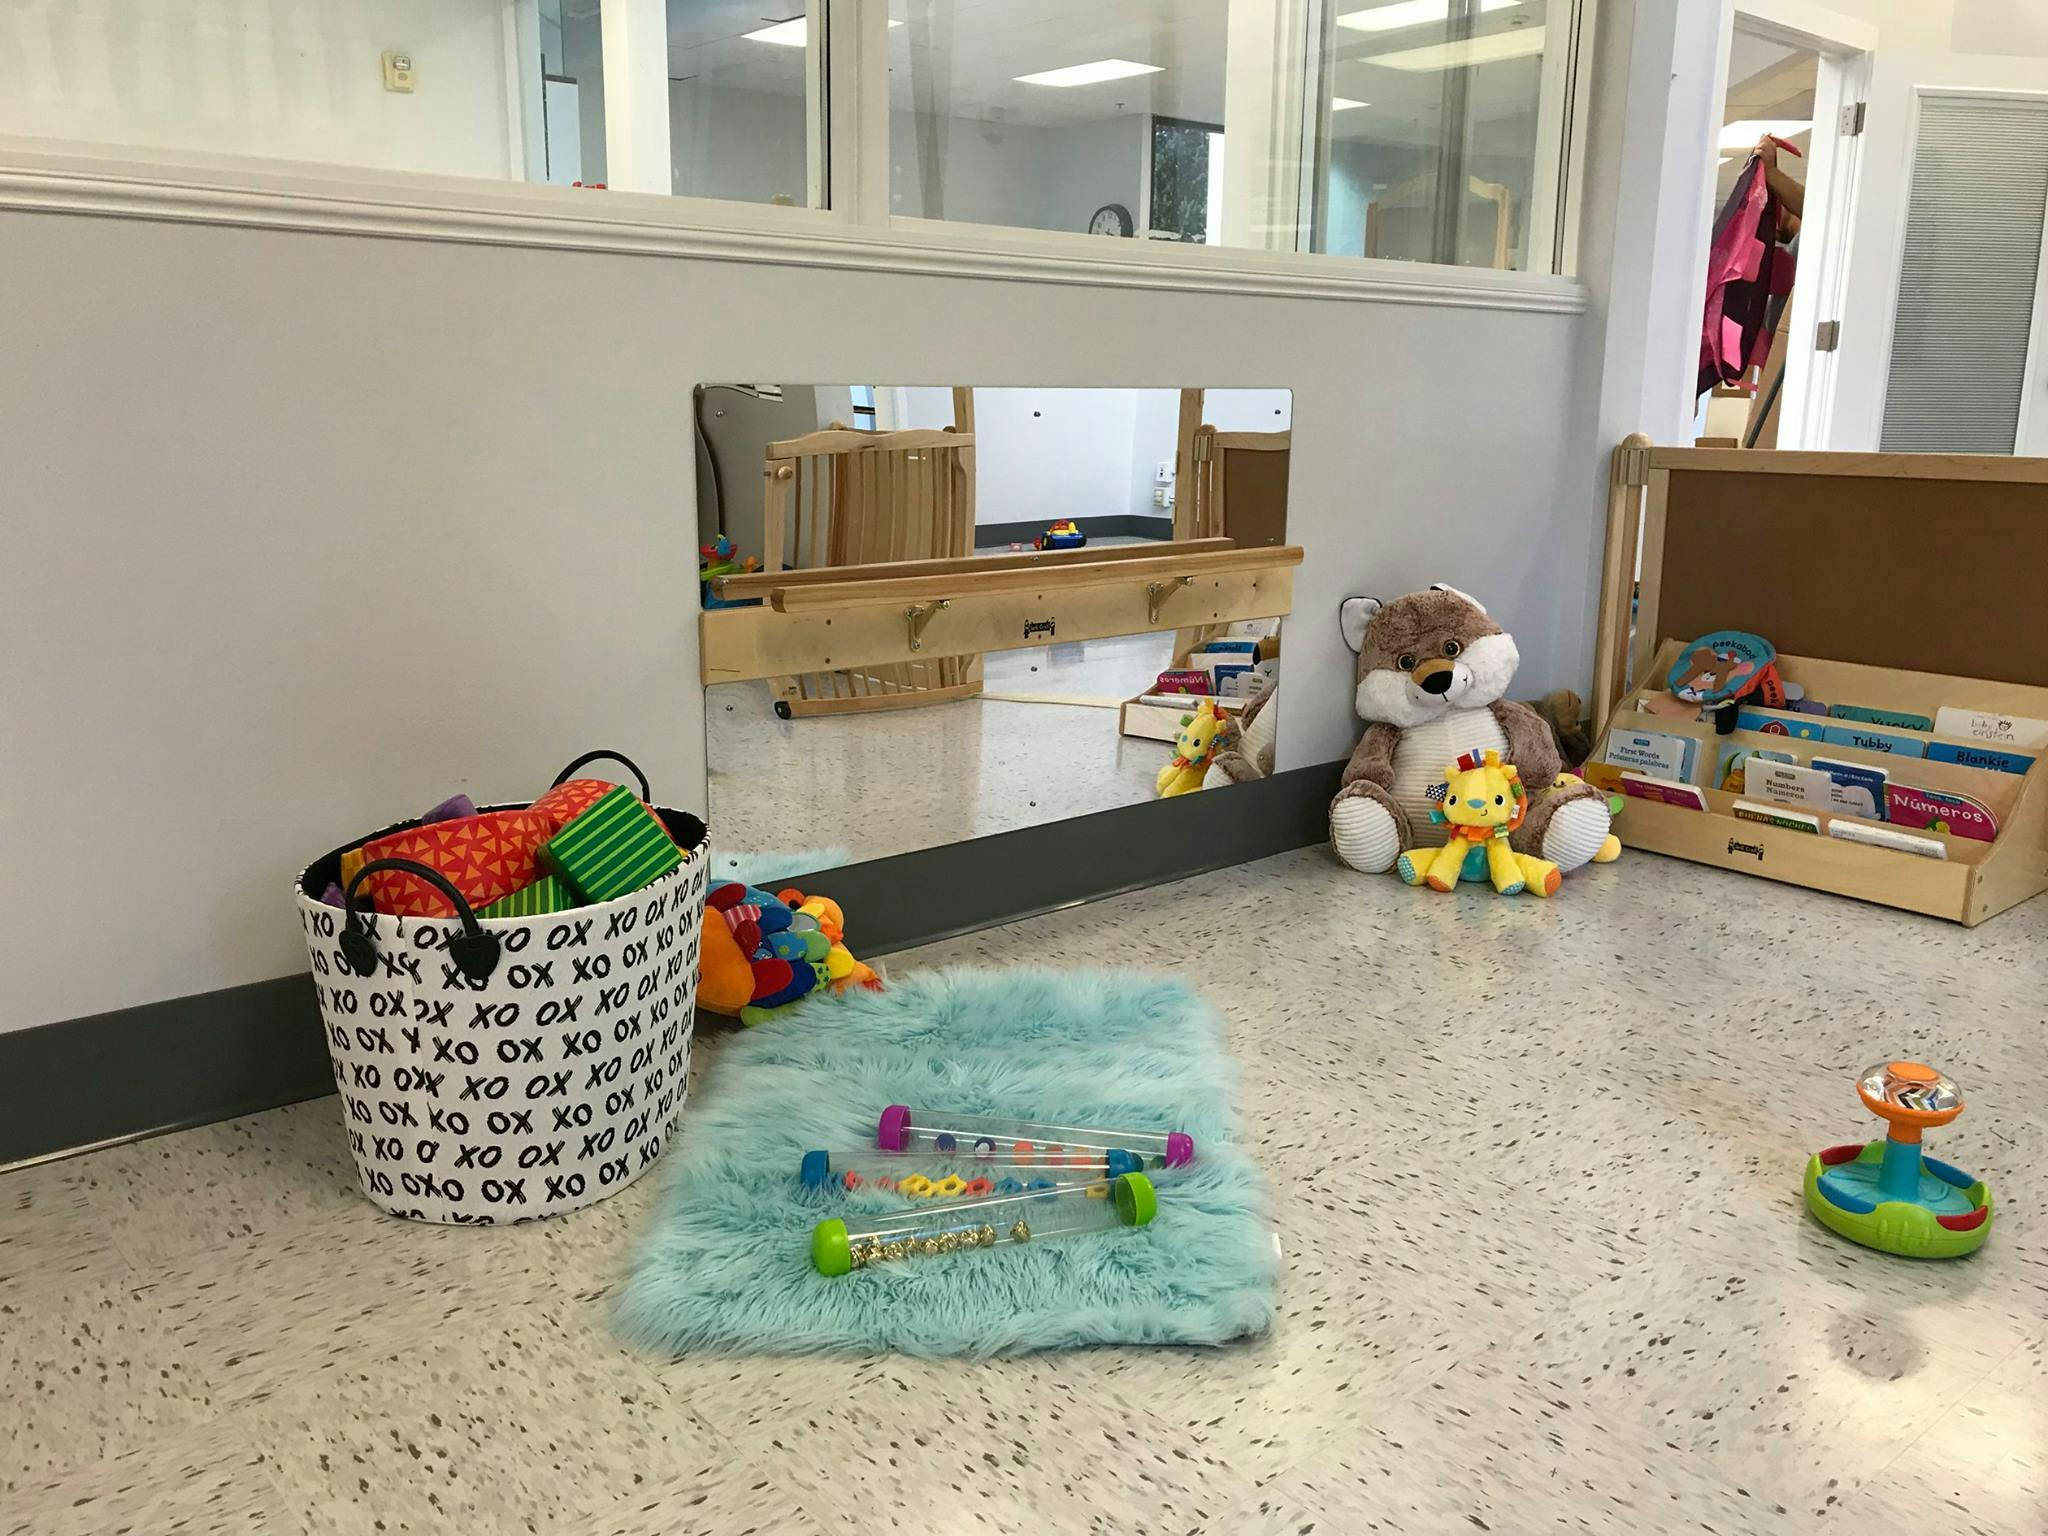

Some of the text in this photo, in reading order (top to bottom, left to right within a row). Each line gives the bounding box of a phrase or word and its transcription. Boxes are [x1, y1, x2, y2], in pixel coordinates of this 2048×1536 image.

[1620, 746, 1660, 760] First Words
[1639, 758, 1670, 769] palabras
[1852, 735, 1892, 752] Tubby
[1957, 751, 2009, 768] Blankie
[1766, 779, 1805, 793] Numbers
[1893, 793, 1983, 823] Números
[309, 910, 334, 938] XO
[547, 919, 593, 950] OX
[604, 907, 637, 940] XO
[645, 893, 667, 926] OX
[671, 878, 688, 912] XO
[310, 946, 329, 975] XO
[507, 961, 554, 989] OX
[572, 954, 611, 984] XO
[623, 936, 648, 968] OX
[656, 925, 673, 956] XO
[679, 906, 693, 936] OX
[327, 1021, 351, 1051] XO
[356, 1027, 394, 1054] OX
[432, 1036, 479, 1065] XO
[497, 1037, 543, 1063] OX
[562, 1030, 602, 1059] XO
[614, 1011, 641, 1042] OX
[650, 997, 668, 1029] XO
[674, 976, 688, 1007] OX
[330, 987, 357, 1014] XO
[370, 990, 407, 1017] OX
[469, 1003, 520, 1029] XO
[536, 995, 583, 1026] OX
[594, 982, 629, 1016] XO
[637, 966, 660, 1000] OX
[665, 950, 682, 984] XO
[346, 1094, 372, 1124] XO
[379, 1101, 418, 1127] OX
[487, 1110, 533, 1135] OX
[552, 1103, 592, 1132] XO
[606, 1083, 634, 1116] OX
[645, 1068, 663, 1100] XO
[669, 1045, 683, 1077] OX
[350, 1062, 380, 1089] XO
[459, 1076, 509, 1101] XO
[525, 1069, 573, 1099] OX
[585, 1057, 621, 1090] XO
[630, 1038, 655, 1073] OX
[660, 1020, 677, 1055] XO
[372, 1135, 403, 1161] XO
[454, 1144, 502, 1169] XO
[518, 1140, 565, 1168] OX
[577, 1127, 615, 1160] XO
[624, 1108, 650, 1143] OX
[655, 1088, 673, 1123] XO
[365, 1167, 393, 1196] XO
[481, 1178, 527, 1205] OX
[545, 1173, 585, 1202] XO
[599, 1153, 629, 1185] OX
[639, 1136, 659, 1169] XO
